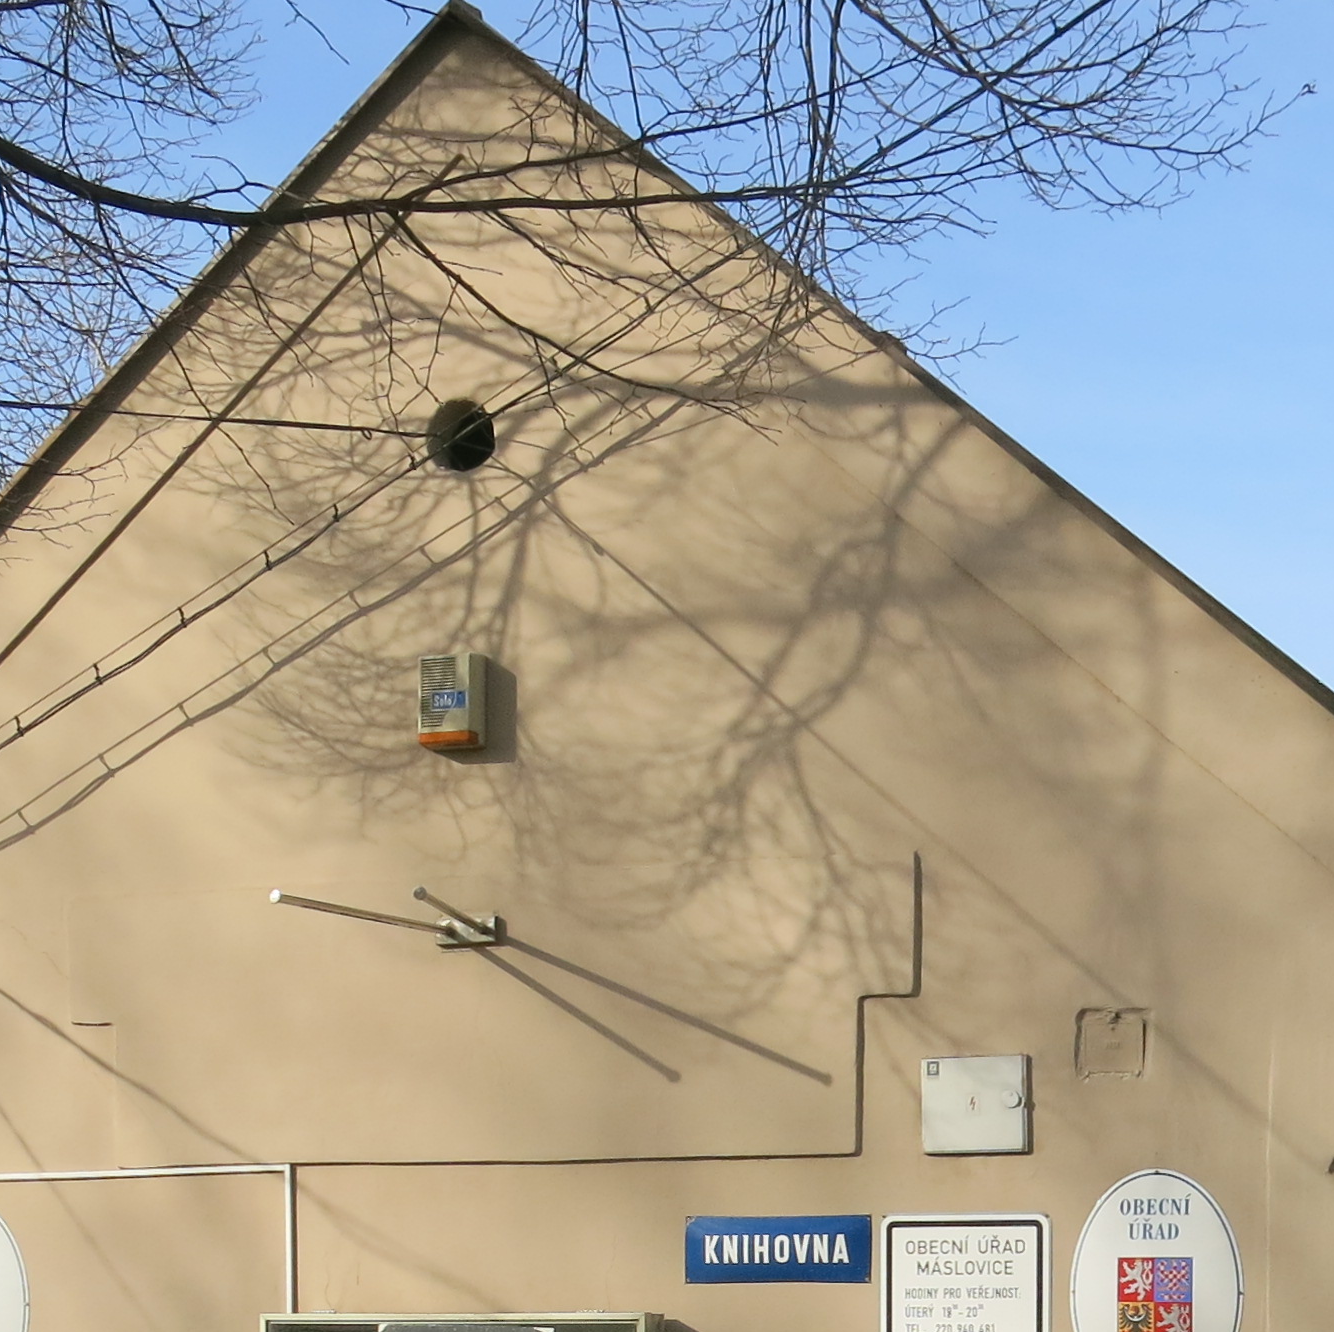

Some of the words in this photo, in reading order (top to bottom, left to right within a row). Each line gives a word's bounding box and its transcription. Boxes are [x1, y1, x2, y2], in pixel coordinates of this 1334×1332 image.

[1119, 1193, 1192, 1216] OBECNÍ
[1128, 1218, 1180, 1240] ÚŘAD
[704, 1233, 850, 1264] KNIHOVNA
[905, 1235, 970, 1255] OBECNÍ
[977, 1235, 1026, 1254] ÚŘAD
[916, 1256, 1014, 1276] MÁSLOVICE
[904, 1287, 939, 1300] HODINY
[943, 1287, 962, 1299] PRO
[904, 1303, 935, 1318] ÚTERÝ
